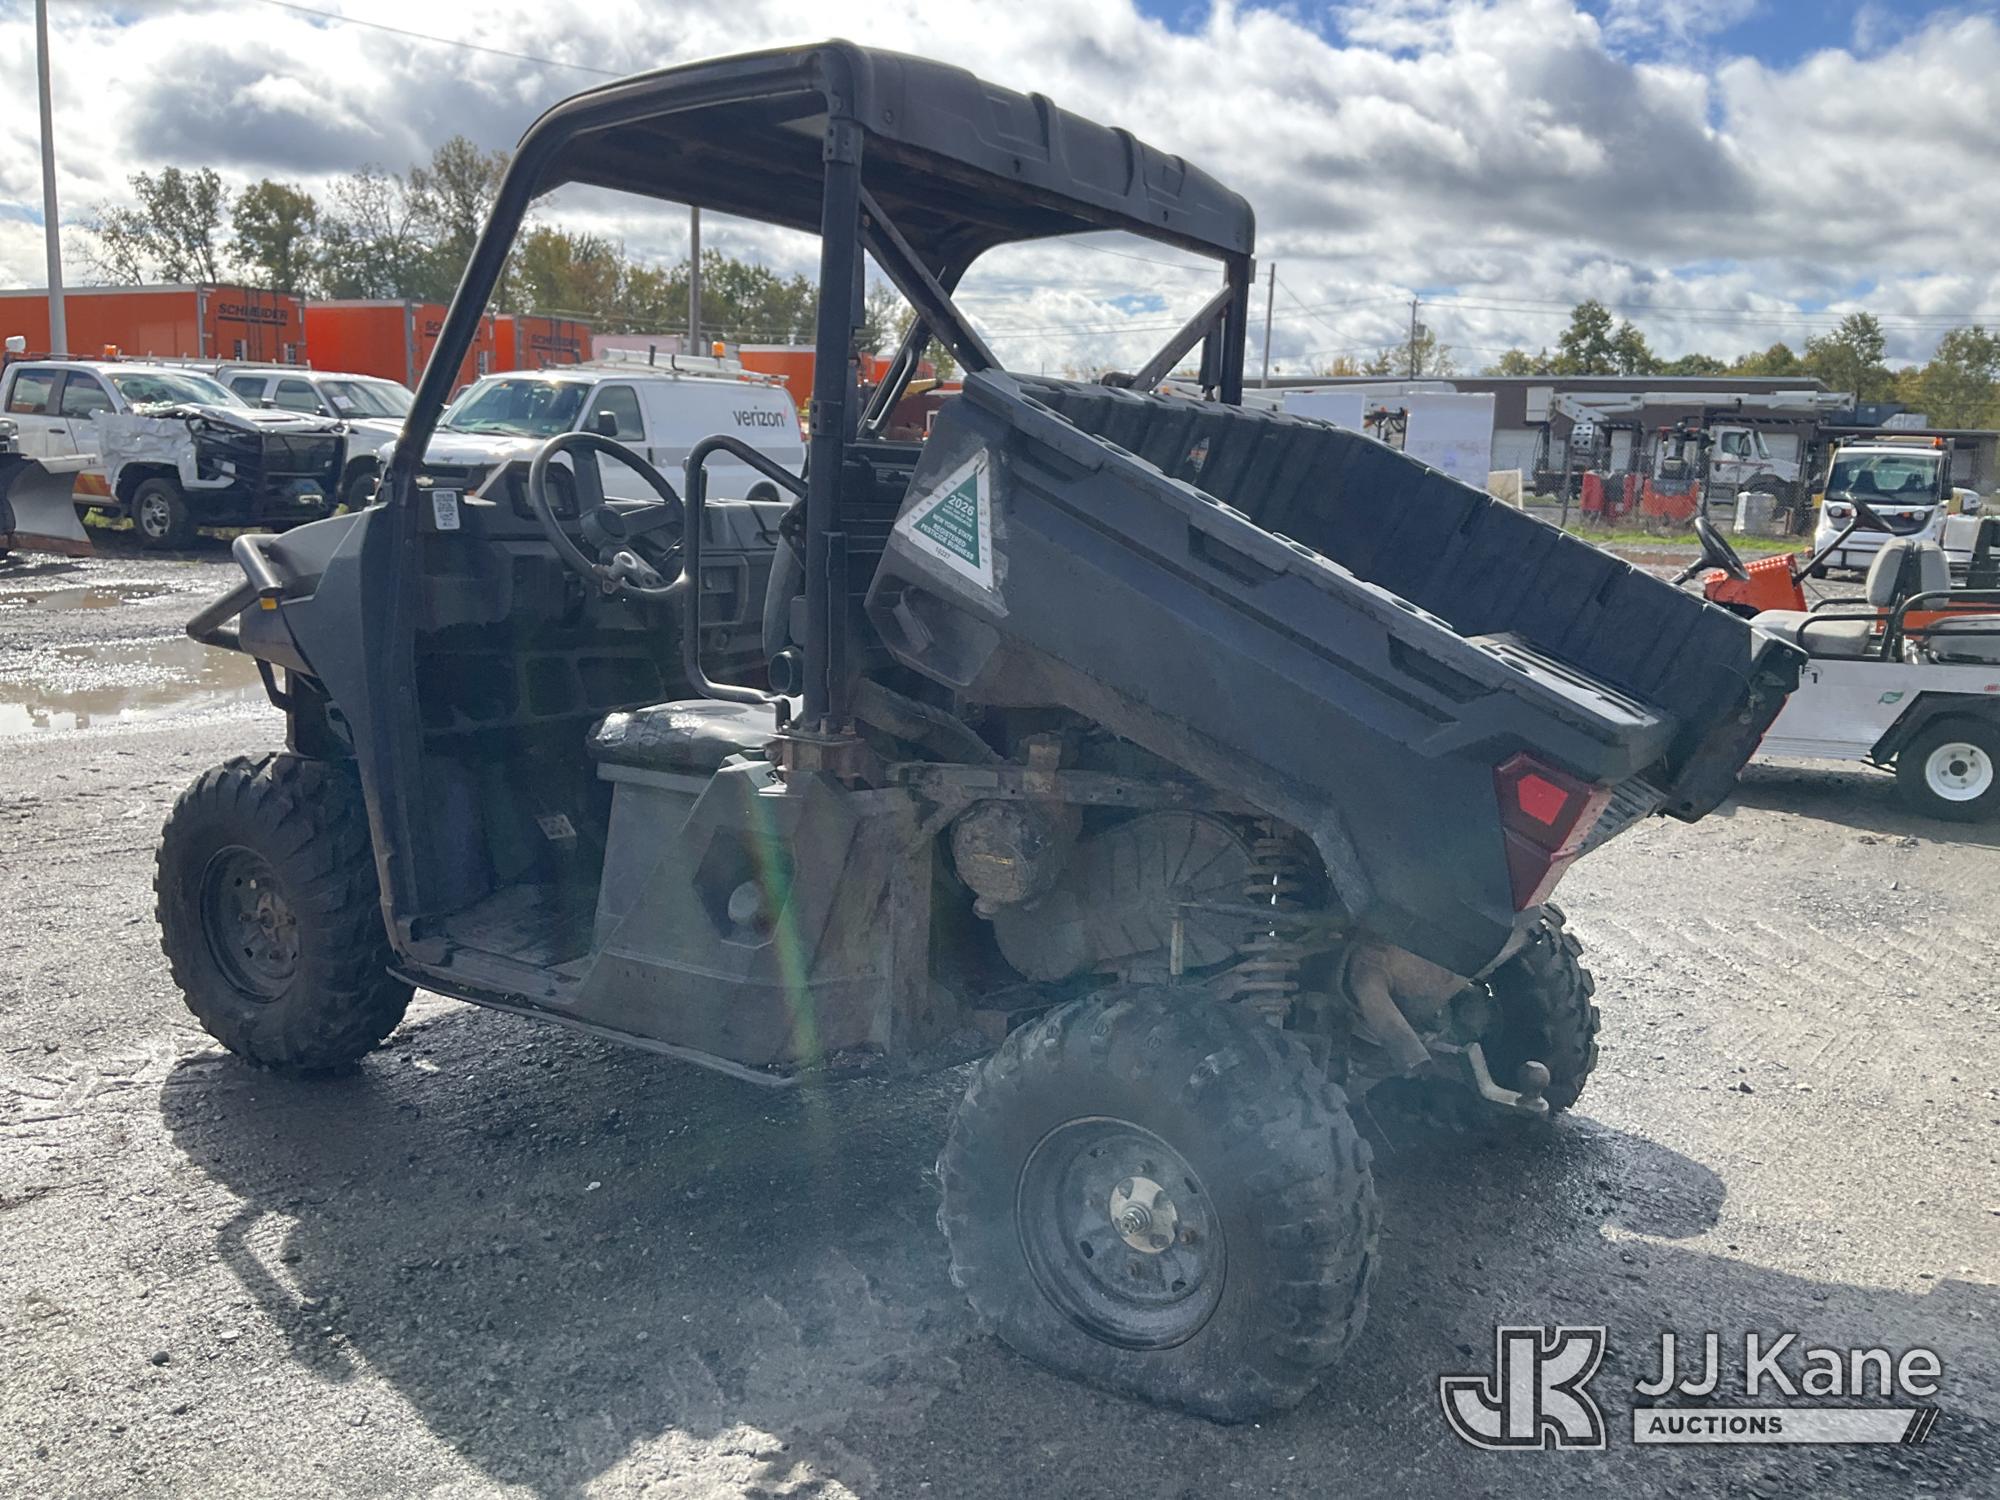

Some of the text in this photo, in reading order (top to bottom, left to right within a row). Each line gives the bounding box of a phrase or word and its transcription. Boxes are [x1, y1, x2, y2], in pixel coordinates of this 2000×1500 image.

[218, 303, 288, 320] SCHNEIDER
[732, 405, 785, 427] verizon
[948, 494, 975, 516] 2026
[932, 513, 973, 542] NEW YORK STATE
[932, 523, 966, 547] REGISTERED
[920, 523, 974, 560] PESTICIDE BUSINESS
